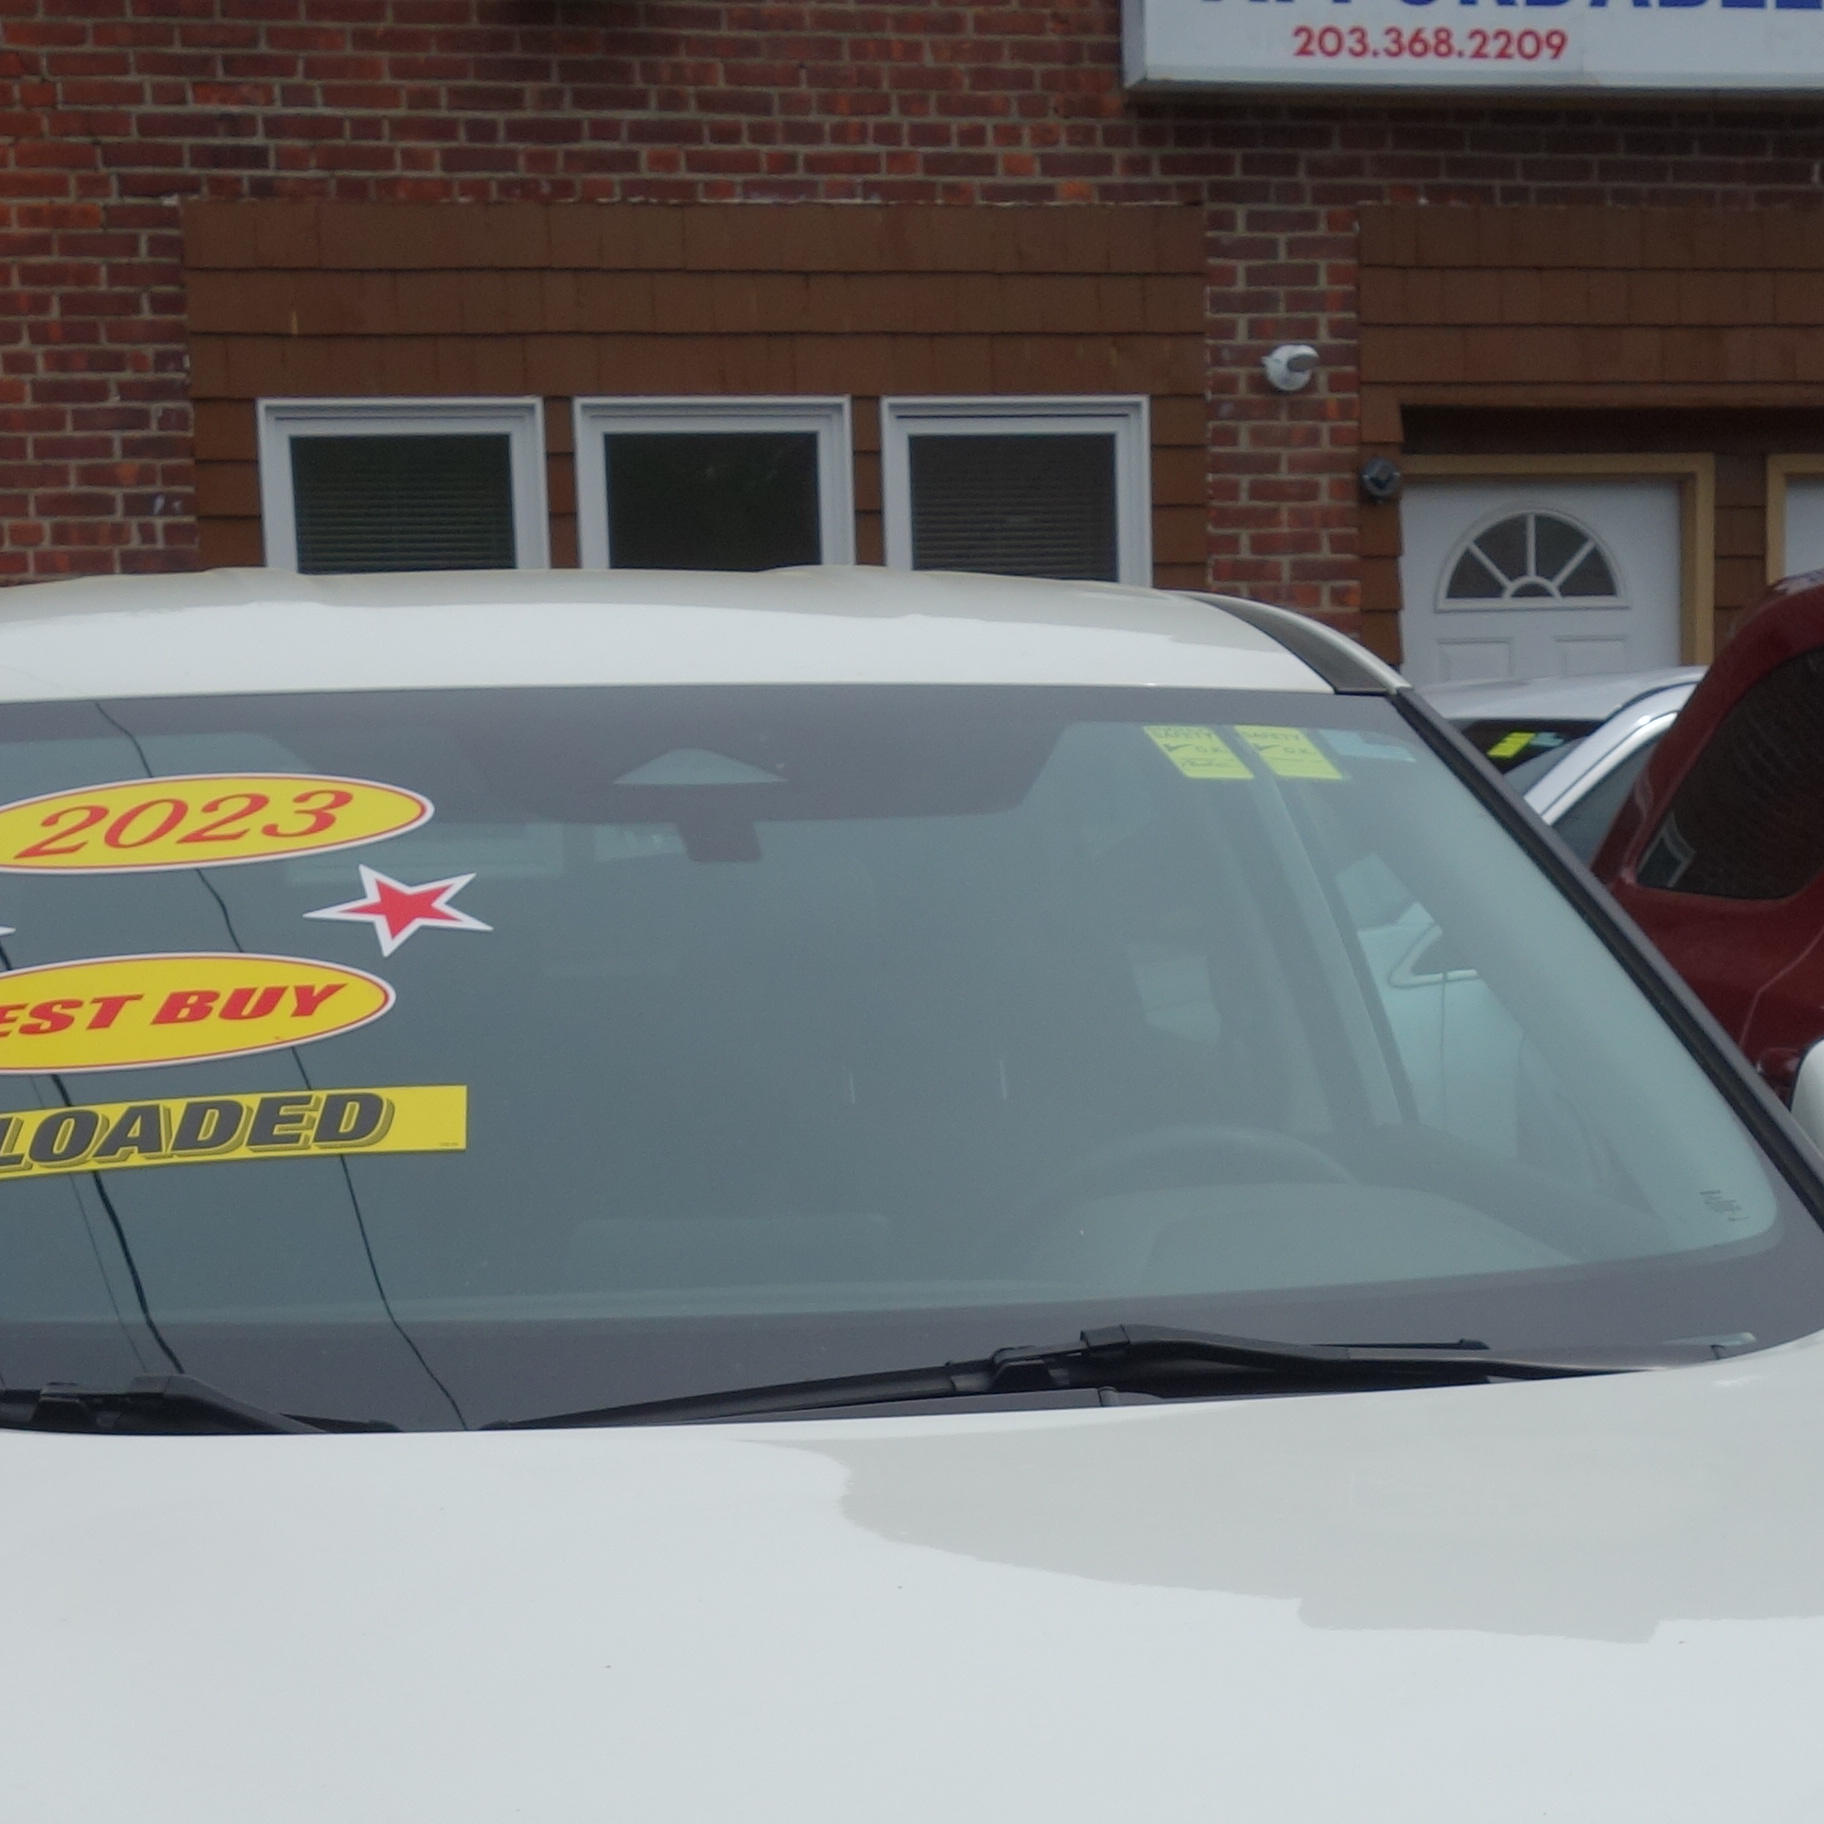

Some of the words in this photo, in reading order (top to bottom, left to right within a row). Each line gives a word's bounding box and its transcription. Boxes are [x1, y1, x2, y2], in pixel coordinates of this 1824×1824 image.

[1291, 25, 1568, 60] 203.368.2209
[13, 789, 354, 859] 2023
[150, 983, 348, 1026] BUY
